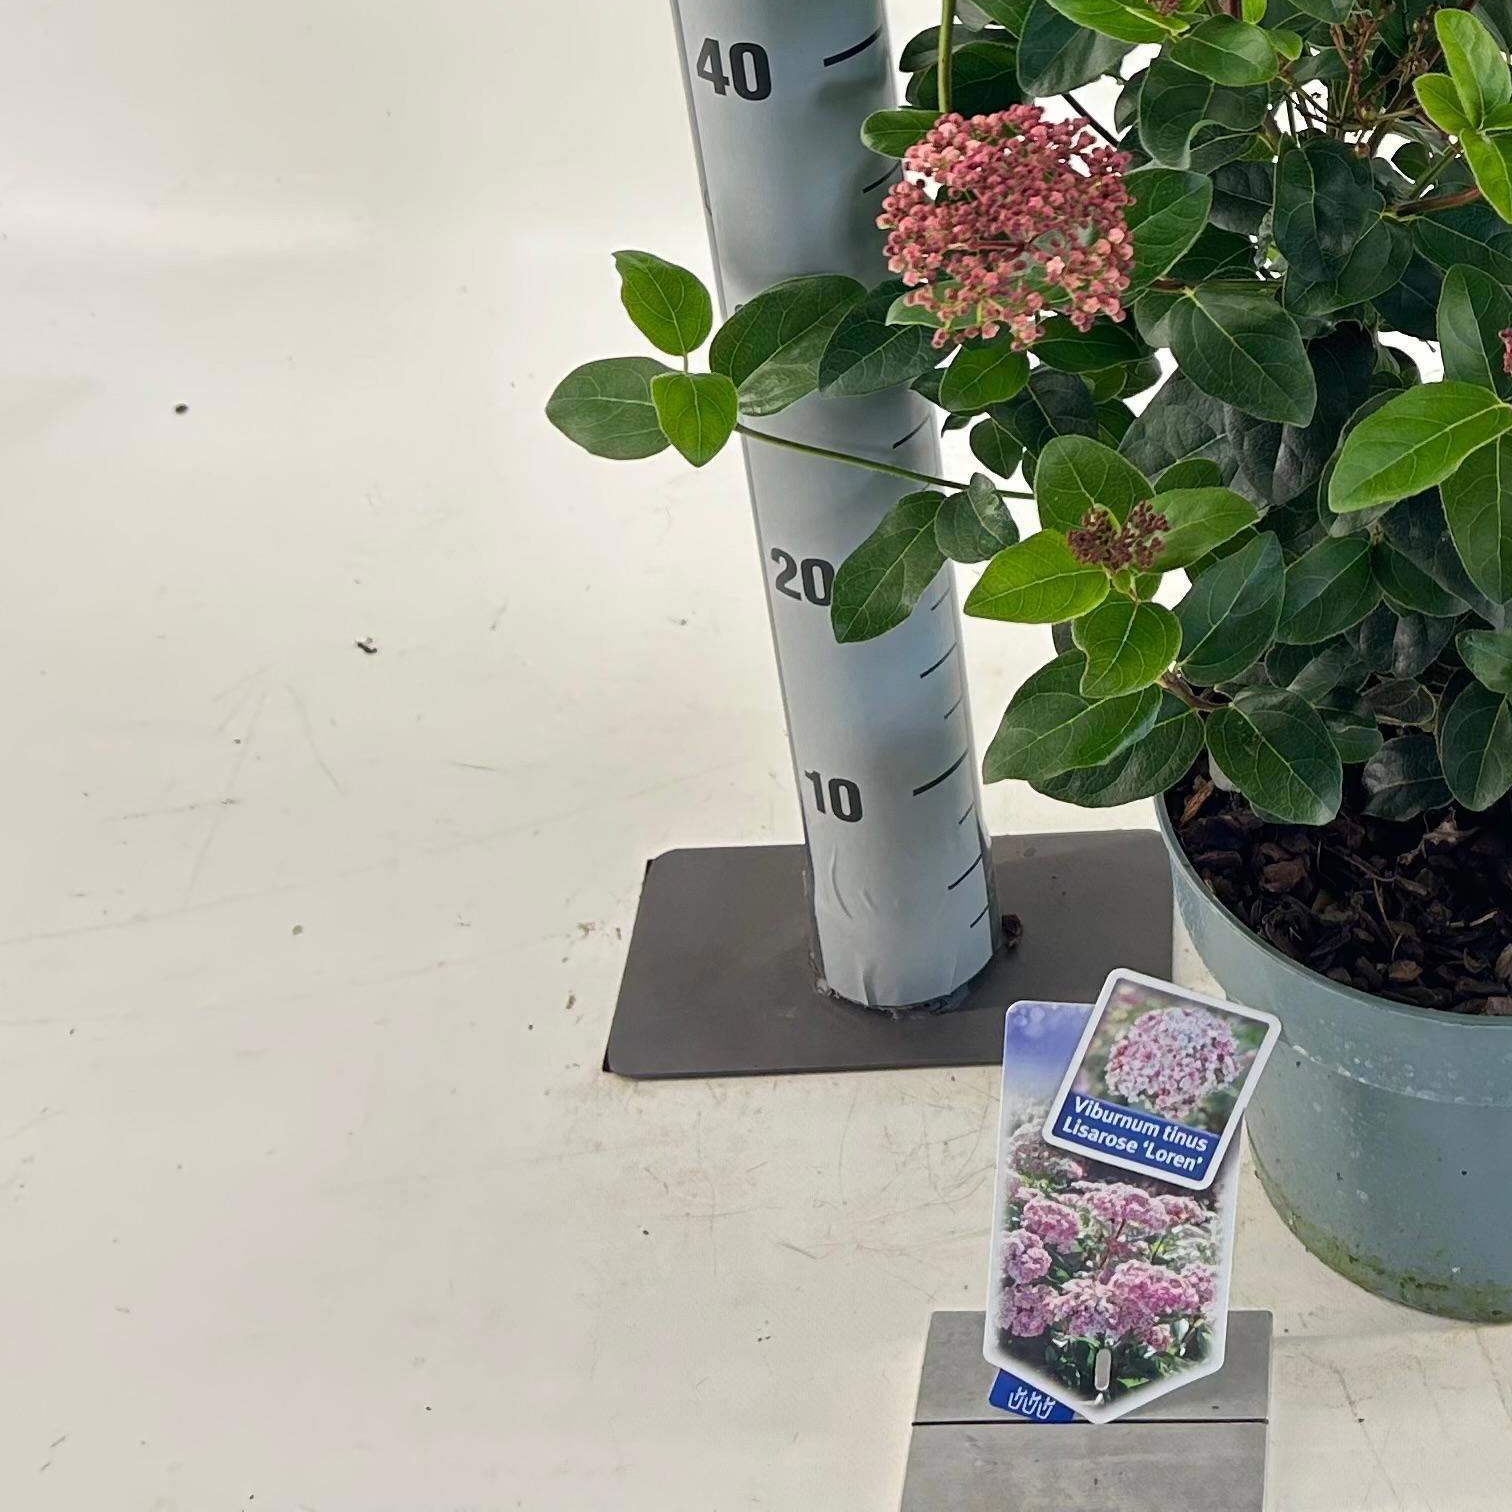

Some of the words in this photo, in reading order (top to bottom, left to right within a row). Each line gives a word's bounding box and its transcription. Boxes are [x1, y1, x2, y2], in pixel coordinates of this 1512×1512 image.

[696, 37, 772, 102] 40
[770, 547, 834, 607] 20
[804, 769, 863, 823] 10
[1062, 1115, 1138, 1153] Lisarose
[1074, 1095, 1160, 1137] Viburnum
[1162, 1125, 1209, 1152] tinus
